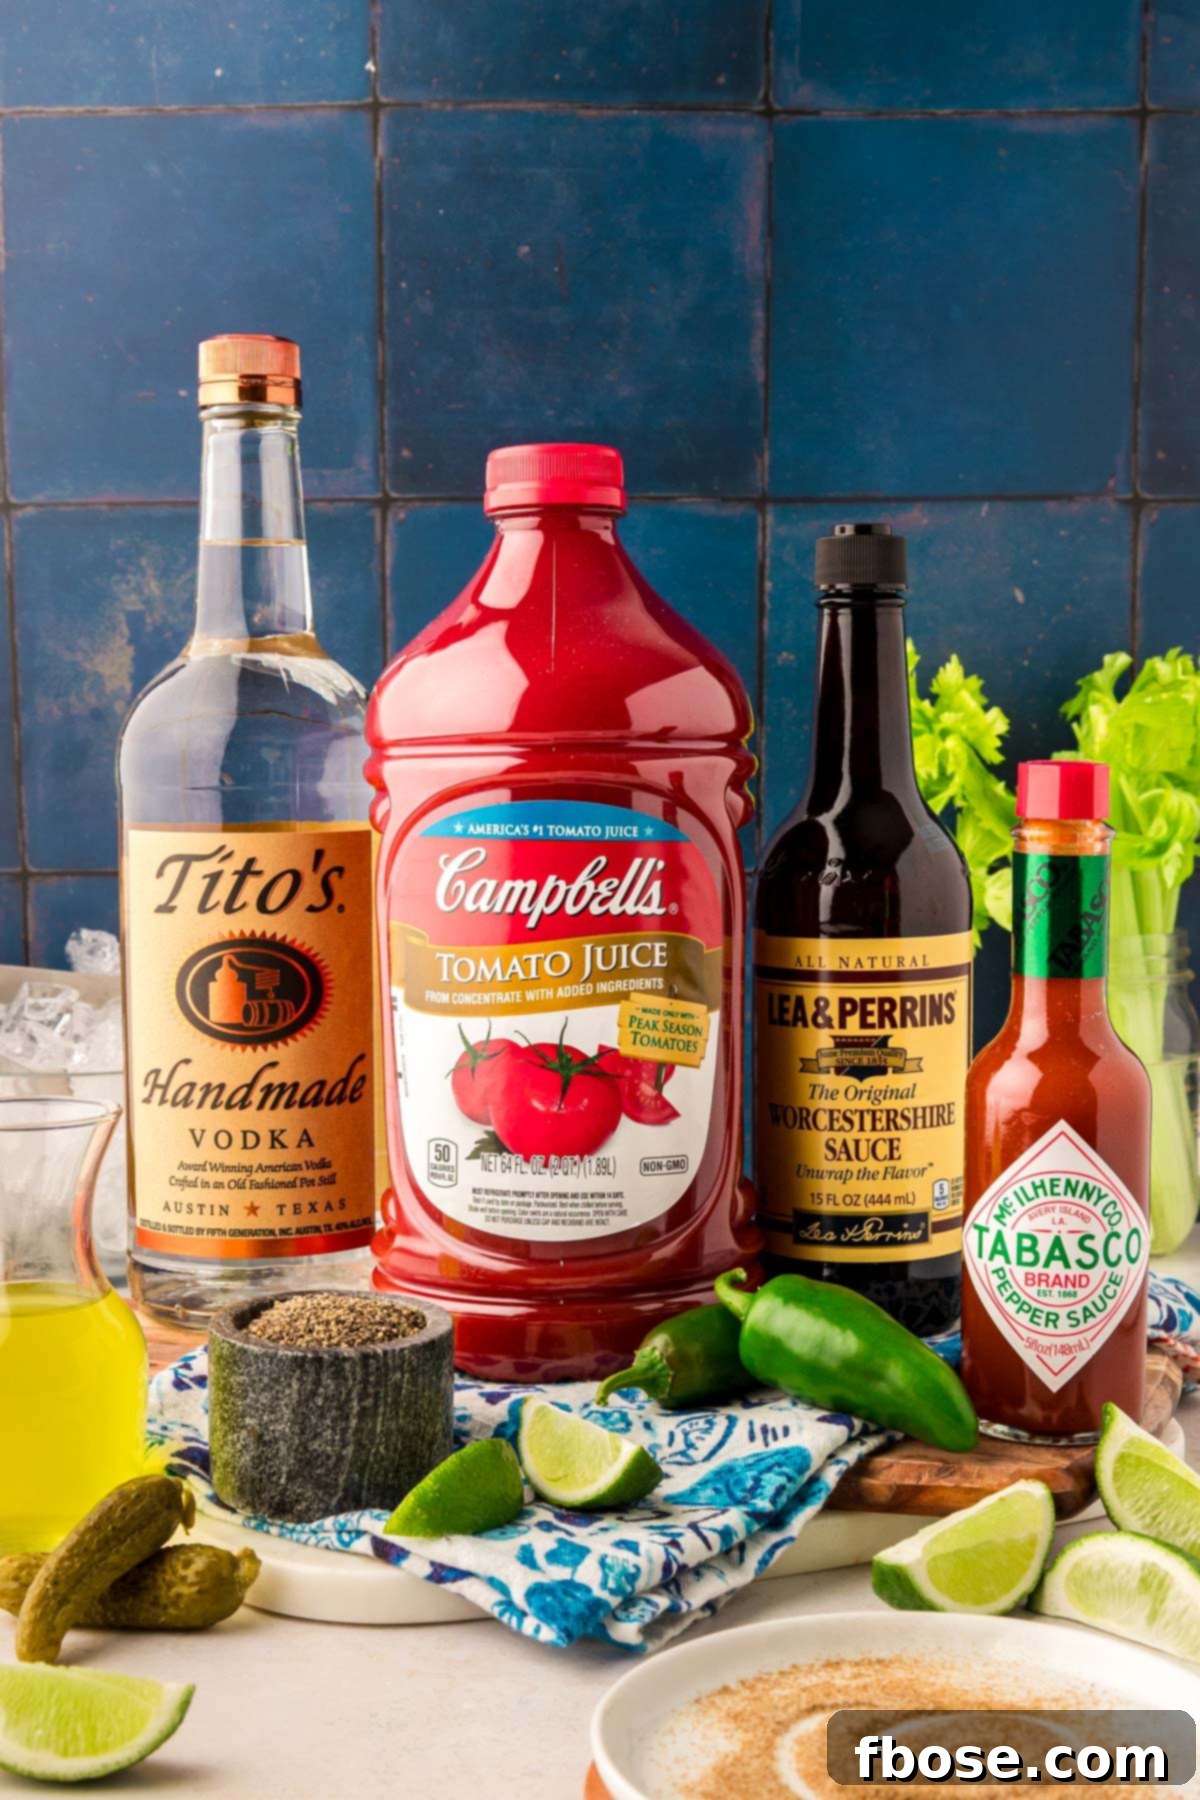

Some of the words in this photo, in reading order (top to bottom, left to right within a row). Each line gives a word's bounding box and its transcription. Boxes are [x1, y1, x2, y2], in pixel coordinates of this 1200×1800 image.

[468, 824, 529, 837] AMERICA'S
[532, 825, 544, 836] #1
[549, 825, 600, 837] TOMATO
[604, 826, 638, 840] JUICE
[436, 847, 667, 928] Campbell's
[435, 950, 572, 984] TOMATO
[580, 942, 669, 982] JUICE
[794, 955, 826, 968] ALL
[838, 954, 930, 969] NATURAL
[425, 989, 450, 1004] FROM
[451, 989, 522, 1005] CONCENTRATE
[525, 987, 554, 1002] WITH
[556, 983, 593, 999] ADDED
[595, 977, 665, 995] INGREDIENTS
[628, 1014, 659, 1032] PEAK
[662, 1019, 703, 1037] SEASON
[631, 1030, 699, 1053] TOMATOES
[835, 1056, 863, 1066] SINCE
[142, 1053, 367, 1112] Handmade
[808, 1083, 840, 1101] The
[843, 1082, 917, 1106] Original
[768, 1102, 956, 1133] WORCESTERSHIRE
[188, 1127, 316, 1150] VODKA
[823, 1137, 903, 1162] SAUCE
[434, 1143, 451, 1163] 50
[177, 1160, 207, 1172] Award
[208, 1162, 253, 1177] Winning
[255, 1161, 303, 1174] American
[304, 1157, 333, 1171] Vodka
[481, 1153, 499, 1173] NET
[500, 1154, 513, 1174] 64
[514, 1155, 528, 1175] FL.
[531, 1155, 547, 1176] OZ.
[583, 1155, 617, 1179] (1.89L)
[642, 1158, 687, 1173] NON-GMO
[796, 1163, 854, 1185] Unwrap
[855, 1166, 880, 1181] the
[881, 1164, 928, 1181] Flavor
[227, 1178, 247, 1191] Old
[248, 1176, 298, 1191] Fashioned
[300, 1177, 316, 1189] Pot
[317, 1172, 338, 1187] Still
[163, 1200, 230, 1216] AUSTIN
[276, 1198, 347, 1216] TEXAS
[809, 1191, 824, 1207] 15
[825, 1192, 840, 1207] FL
[841, 1193, 862, 1208] OZ
[863, 1193, 892, 1209] (444
[893, 1190, 917, 1207] mL)
[1027, 1206, 1056, 1222] AVERY
[1058, 1206, 1092, 1225] ISLAND
[972, 1222, 1143, 1270] TABASCO
[1024, 1271, 1090, 1289] BRAND
[991, 1267, 1060, 1330] PEPPER
[1066, 1271, 1124, 1329] SAUCE
[1037, 1288, 1057, 1299] EST.
[1057, 1289, 1078, 1299] 1868
